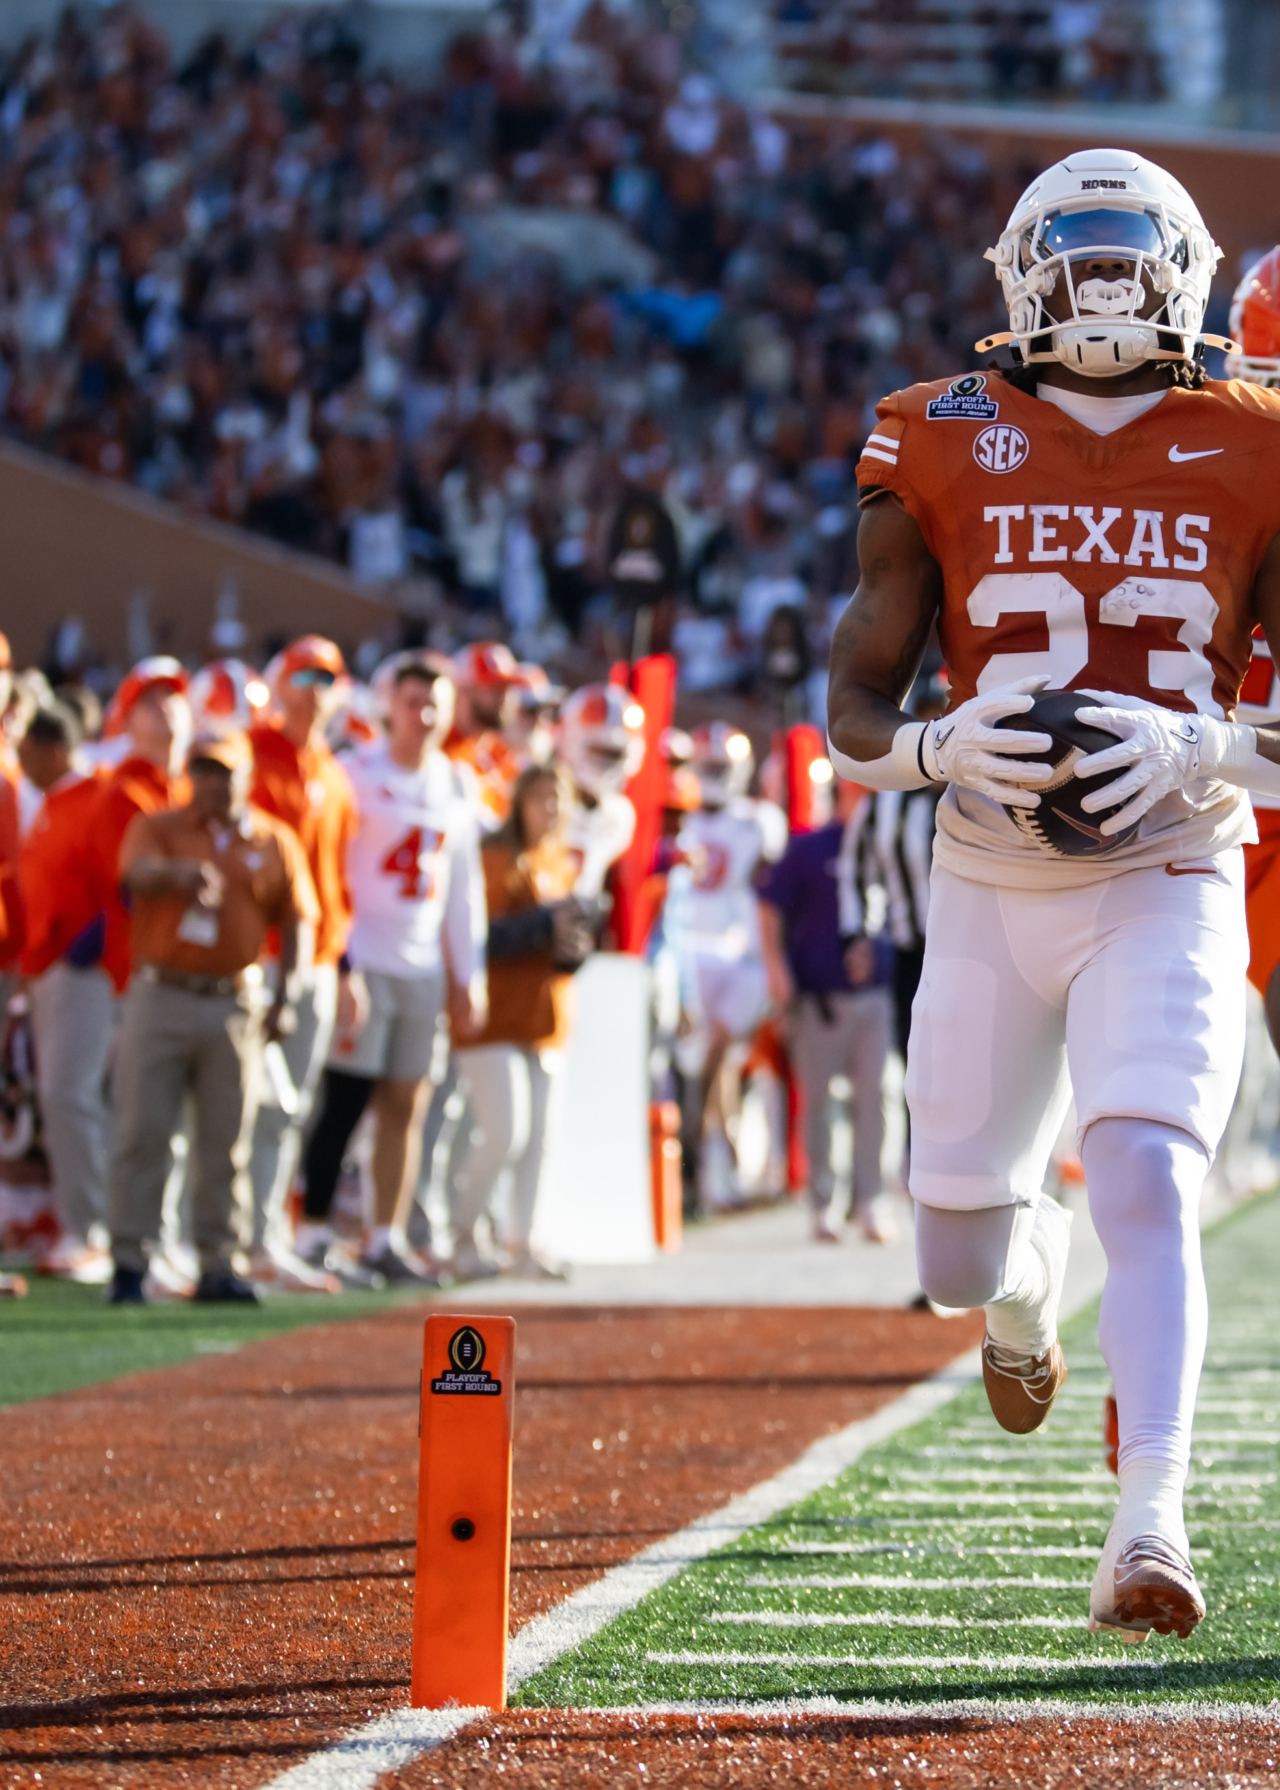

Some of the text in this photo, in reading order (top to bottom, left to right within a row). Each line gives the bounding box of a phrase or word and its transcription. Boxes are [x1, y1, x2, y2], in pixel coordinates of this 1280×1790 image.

[1081, 179, 1126, 190] HORNS
[931, 402, 995, 411] FIRST ROUND
[978, 427, 1024, 470] SEC
[984, 504, 1210, 572] TEXAS
[967, 572, 1225, 721] 23
[445, 1374, 487, 1382] PLAYOFF
[435, 1382, 498, 1391] FIRST ROUND
